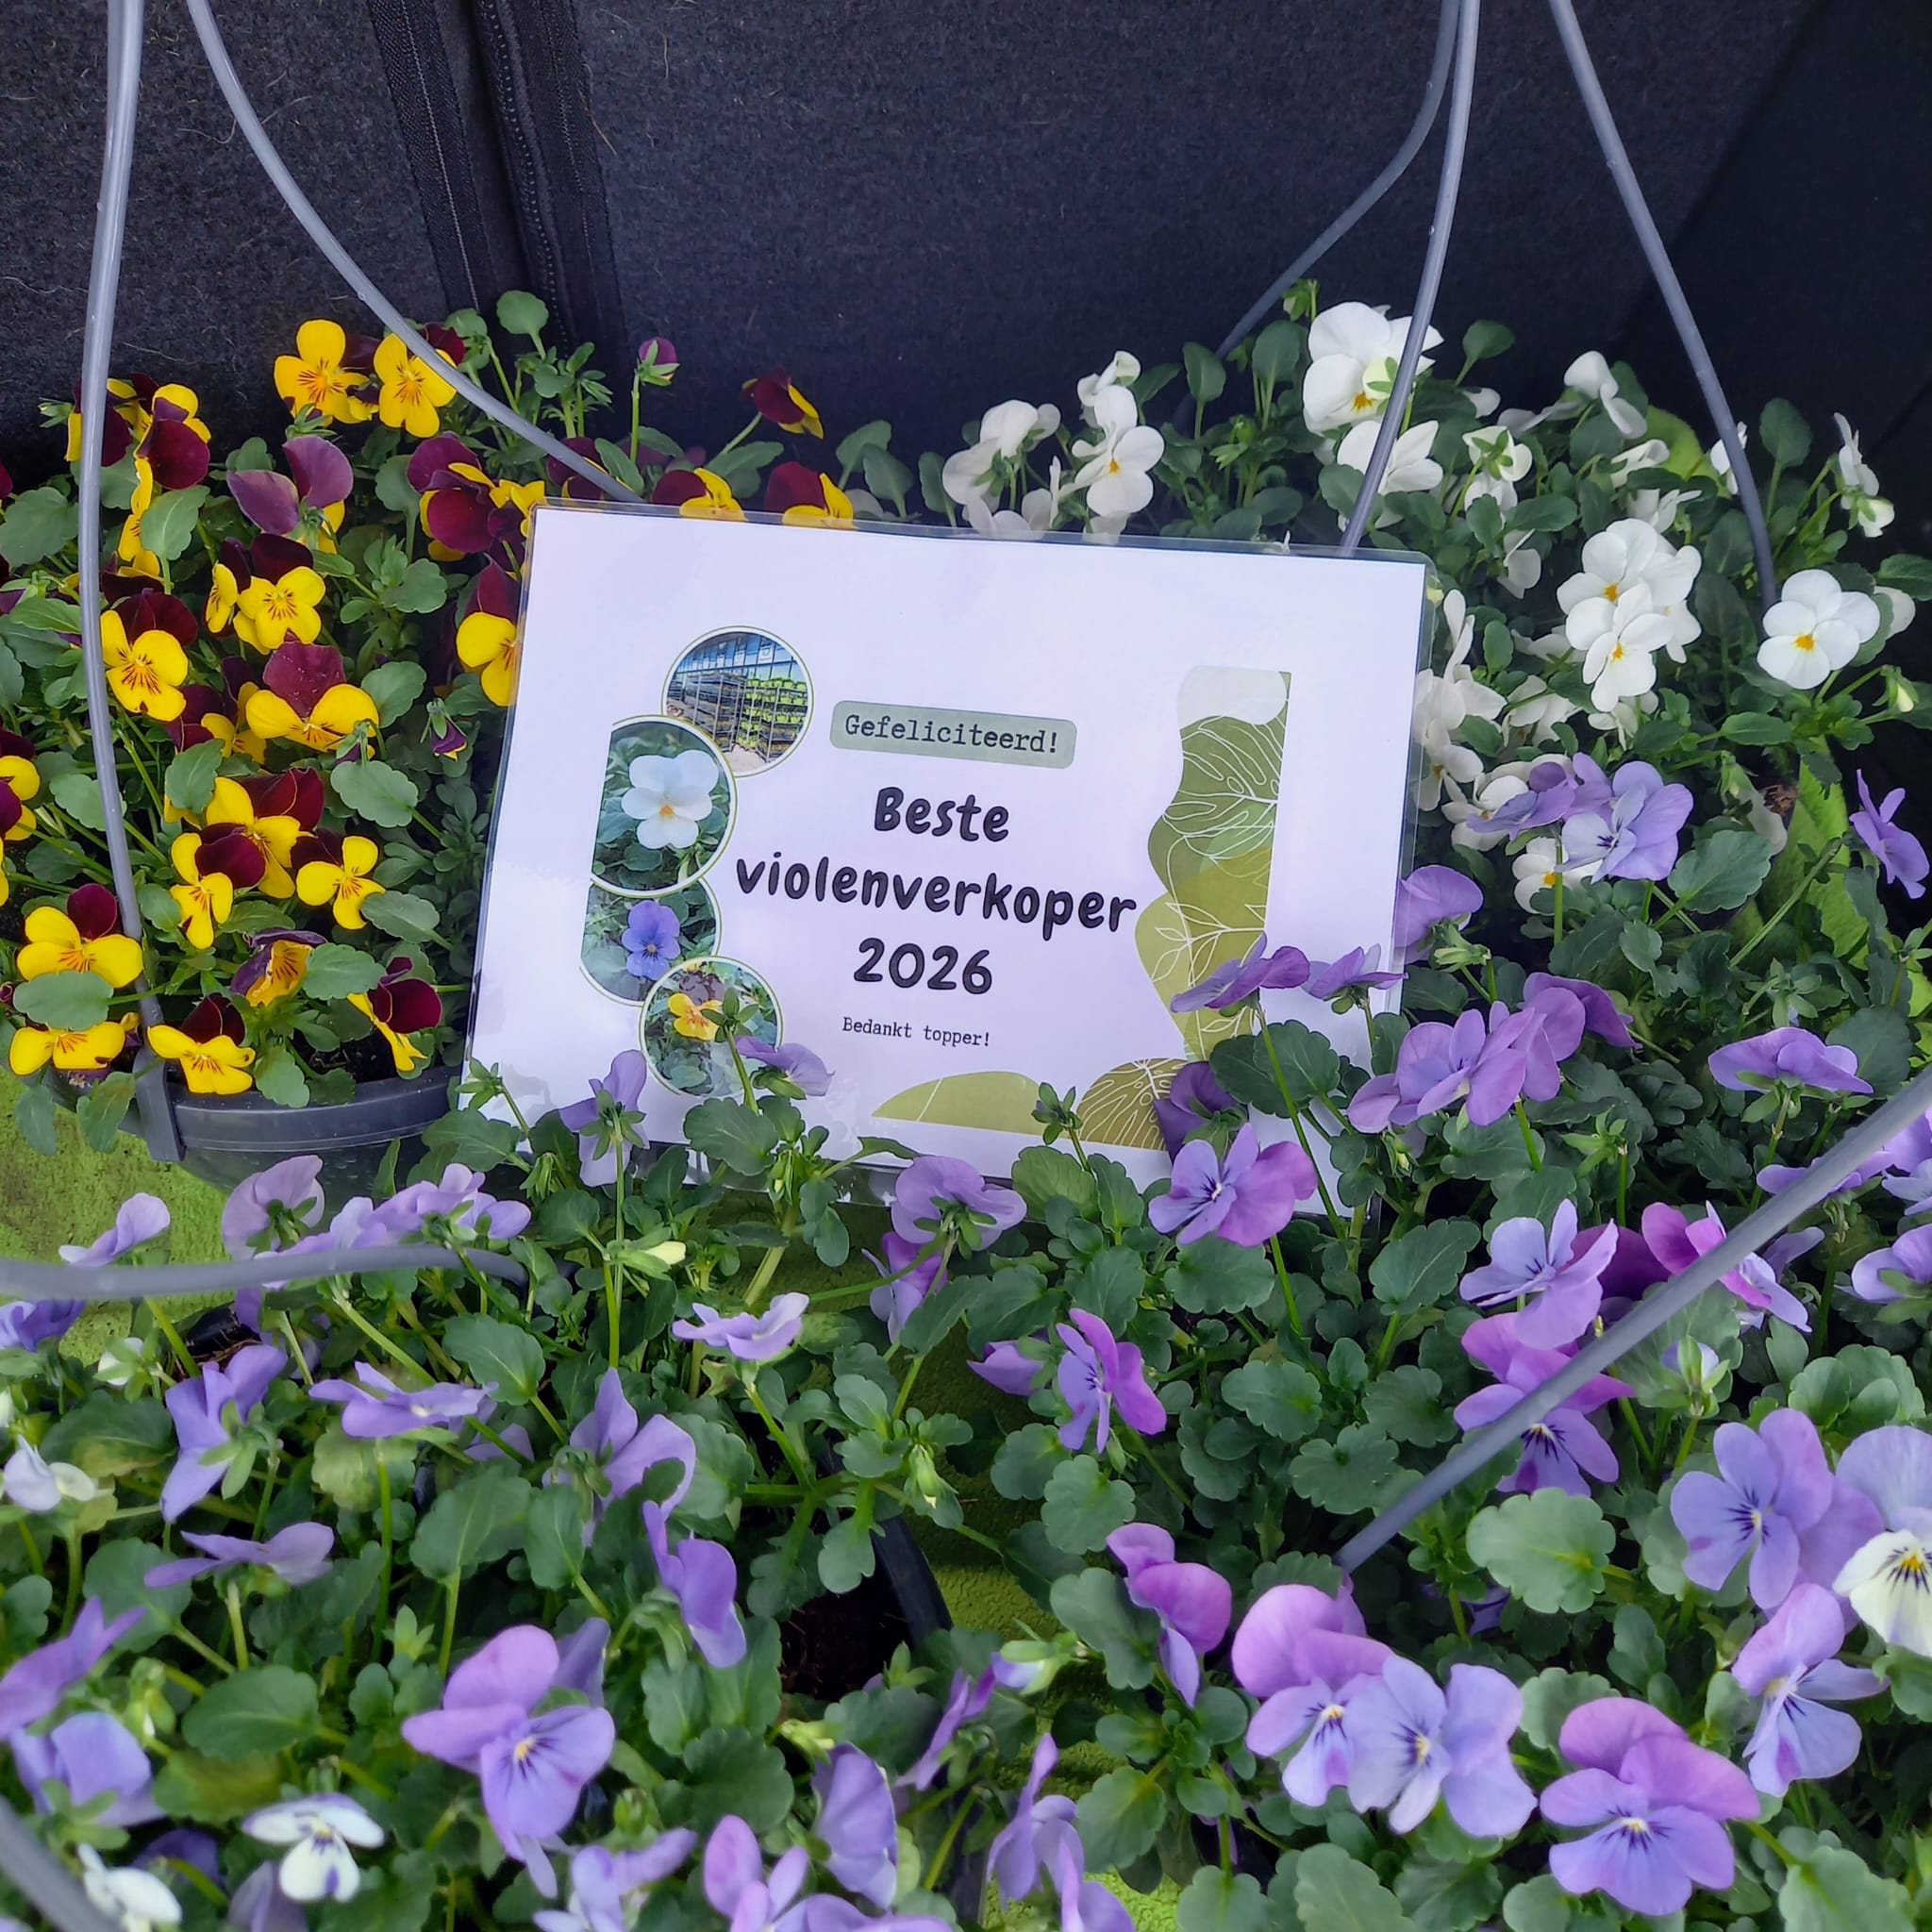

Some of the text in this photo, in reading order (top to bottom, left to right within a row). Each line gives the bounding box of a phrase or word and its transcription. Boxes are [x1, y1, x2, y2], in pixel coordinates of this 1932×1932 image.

[845, 714, 1058, 754] Gefeliciteerd!
[874, 786, 1009, 842] Beste
[736, 851, 1138, 941] violenverkoper
[853, 937, 993, 995] 2026
[841, 1016, 990, 1048] Bedankt topper!
